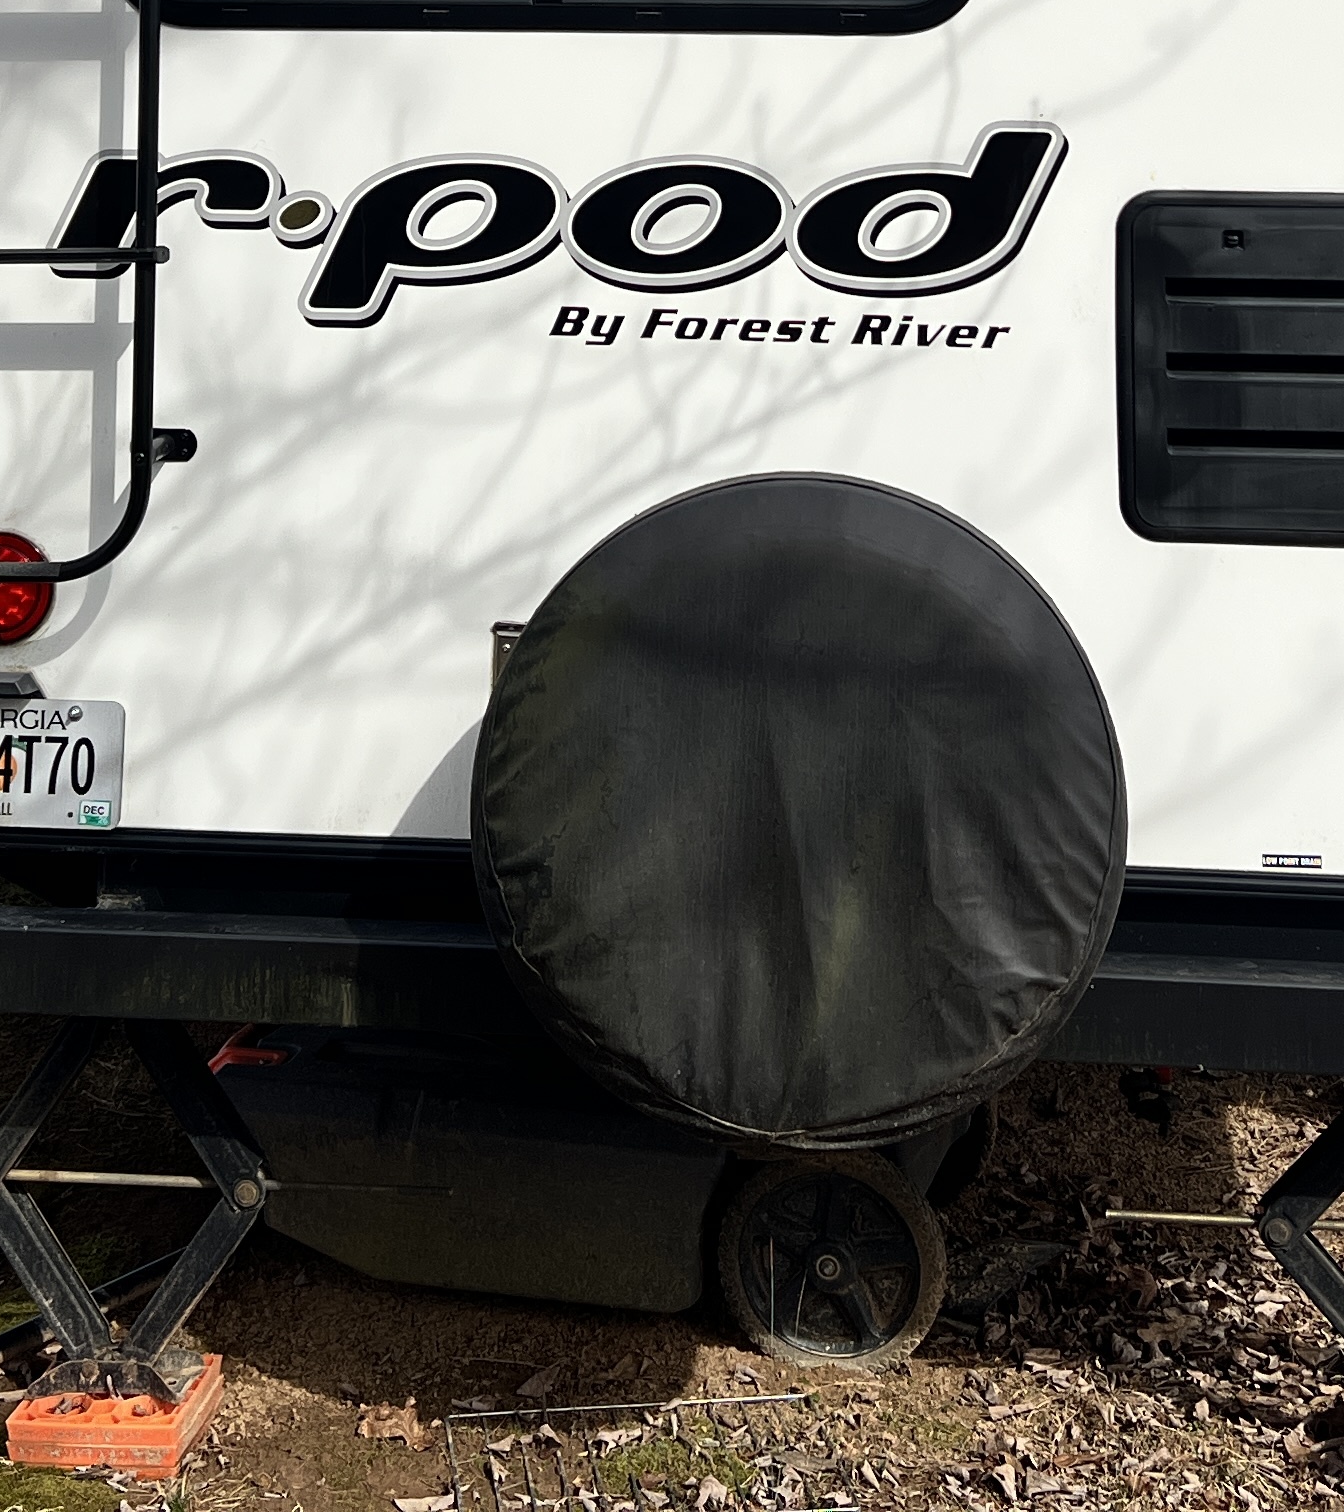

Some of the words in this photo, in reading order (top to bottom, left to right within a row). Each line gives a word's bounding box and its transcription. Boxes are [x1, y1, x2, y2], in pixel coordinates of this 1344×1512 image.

[549, 305, 625, 346] By
[640, 308, 836, 345] Forest
[851, 313, 1012, 350] River
[83, 805, 105, 815] DEC
[1263, 856, 1278, 865] LOW
